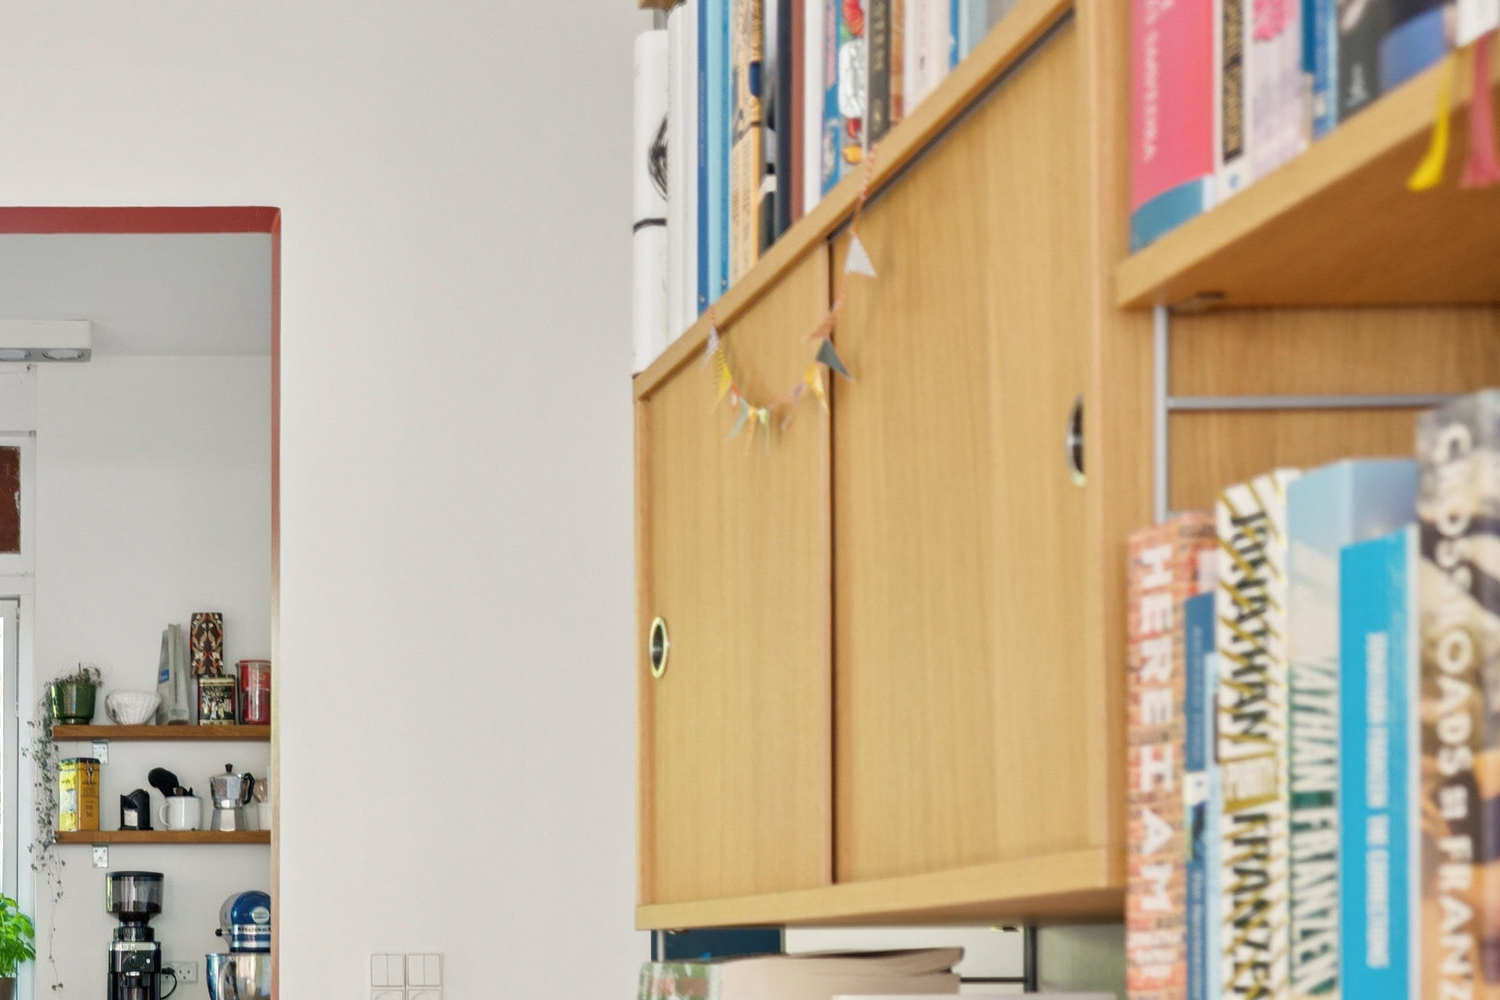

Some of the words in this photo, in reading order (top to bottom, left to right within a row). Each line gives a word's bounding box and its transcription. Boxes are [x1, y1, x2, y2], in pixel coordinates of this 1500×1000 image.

[1140, 542, 1174, 729] HERE
[1230, 510, 1271, 743] JONATHAN
[1140, 744, 1174, 795] I
[1140, 808, 1174, 912] AM
[1290, 805, 1340, 997] FRANZEN
